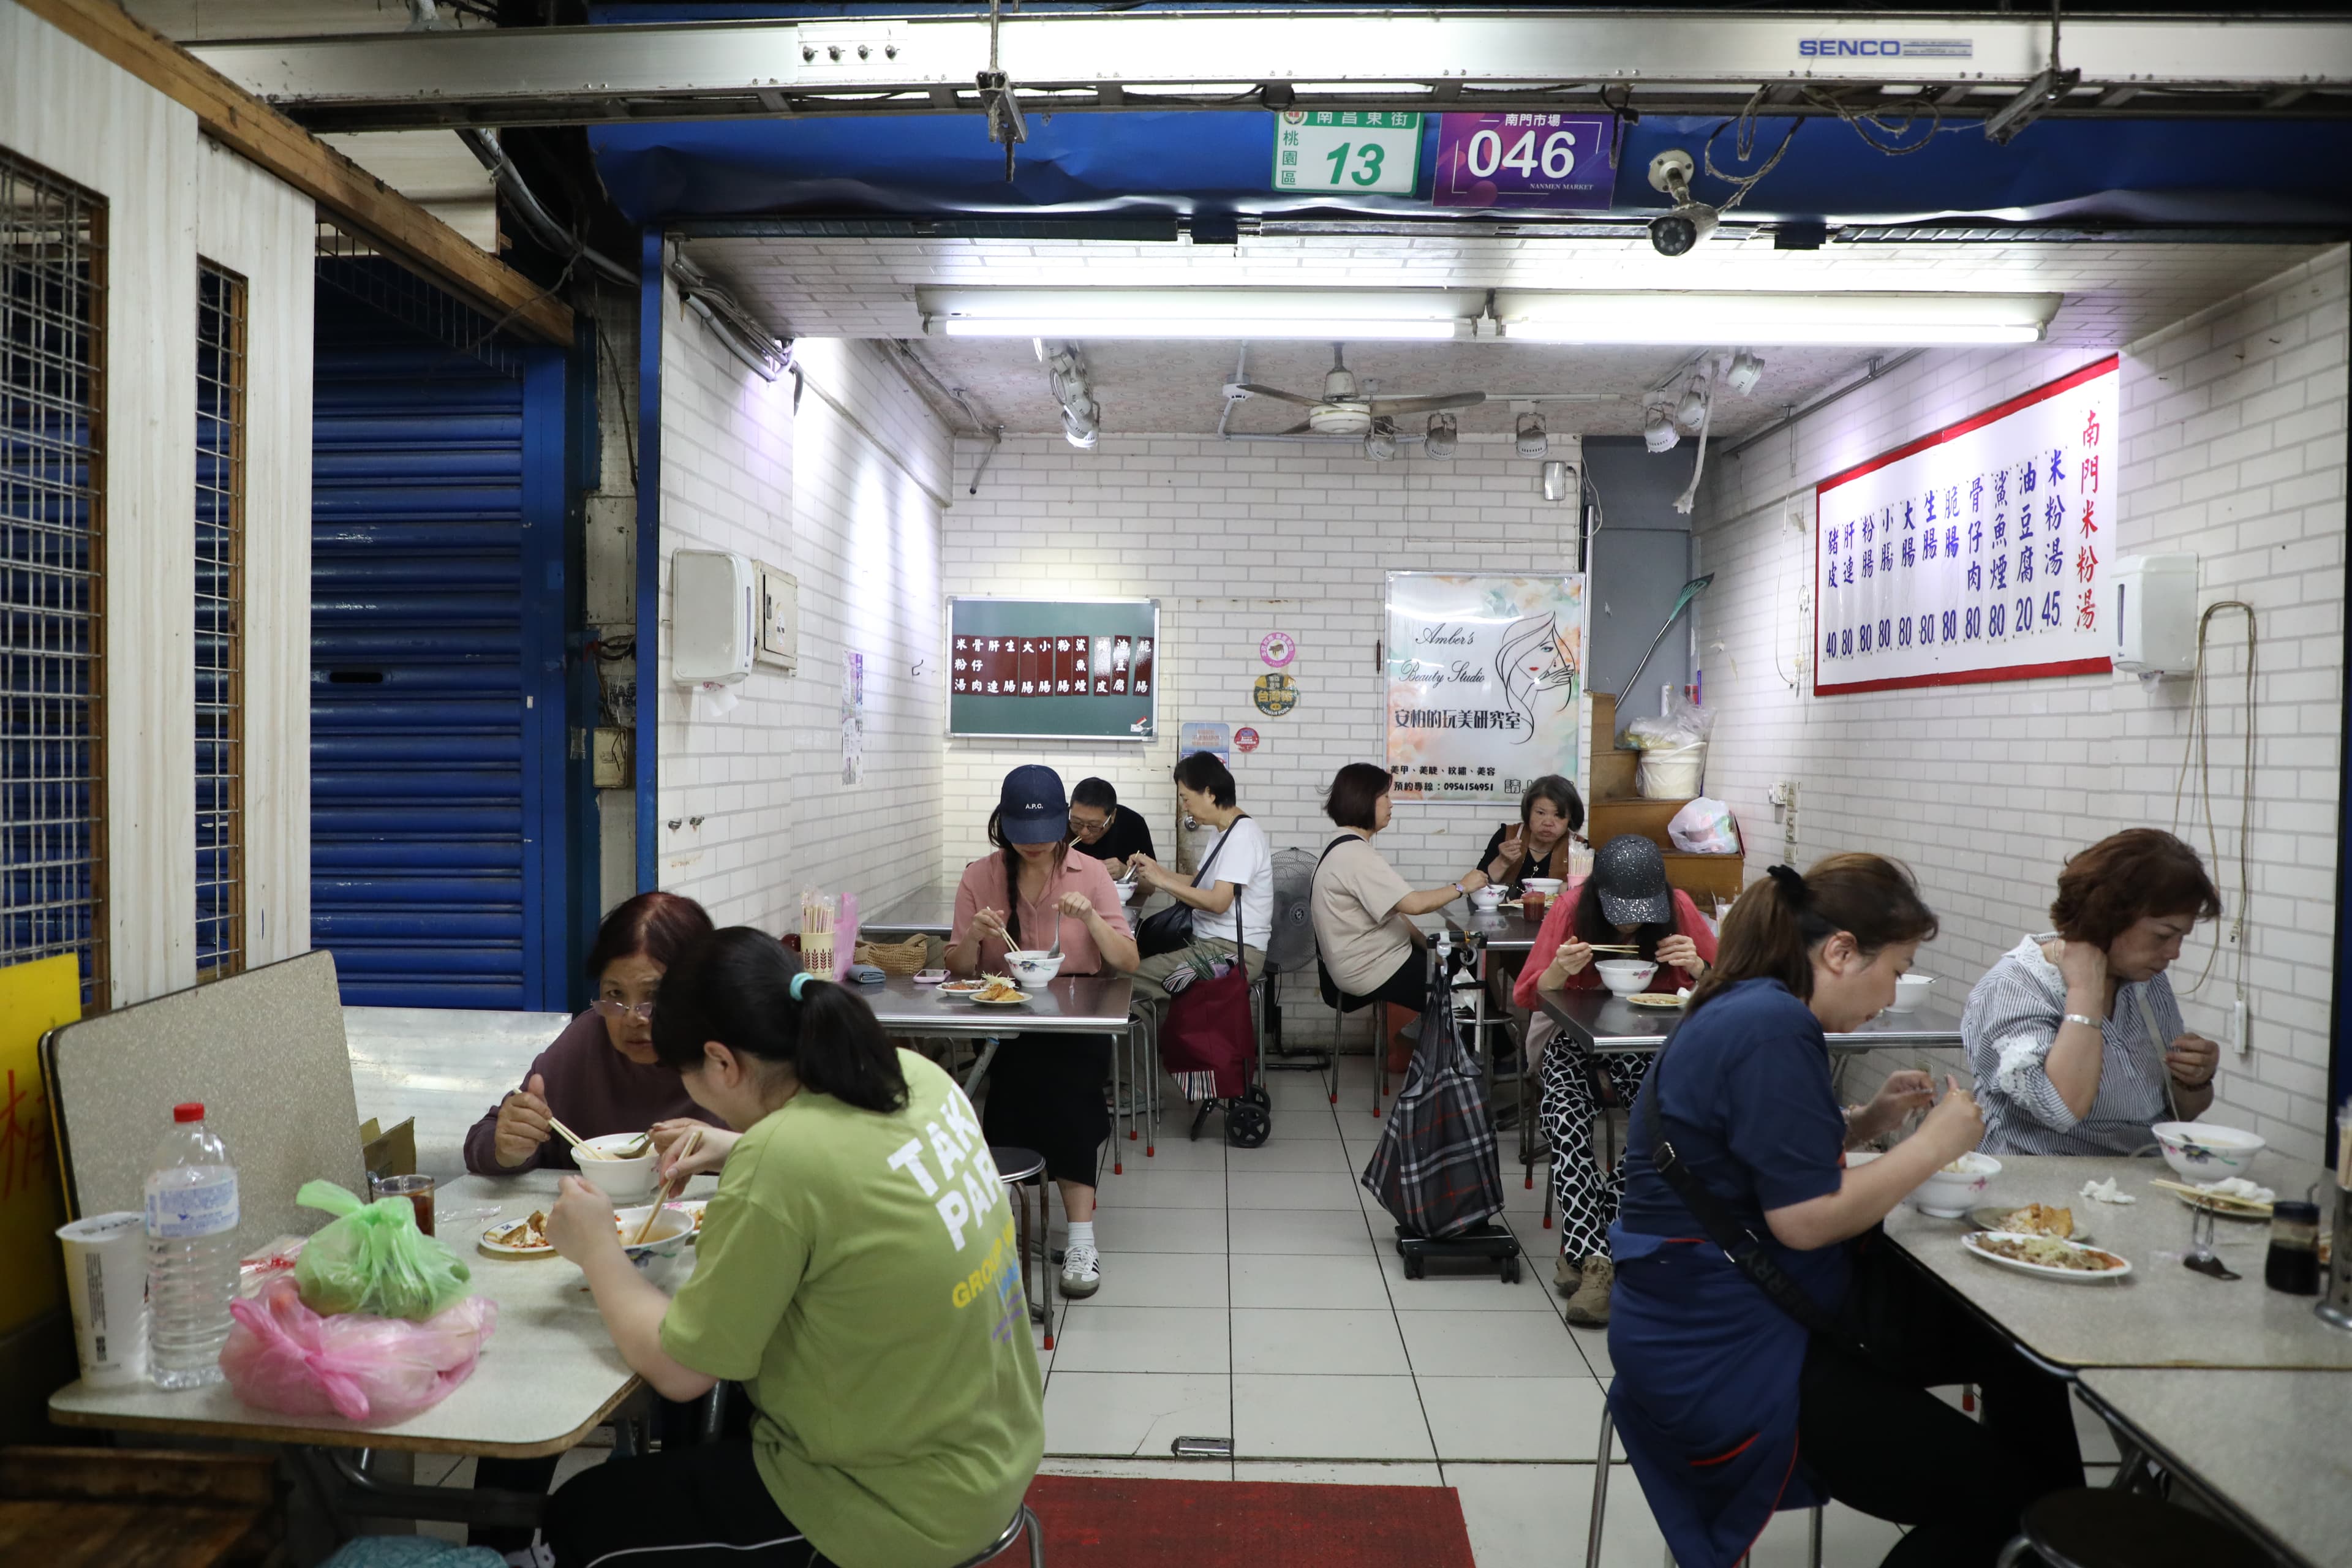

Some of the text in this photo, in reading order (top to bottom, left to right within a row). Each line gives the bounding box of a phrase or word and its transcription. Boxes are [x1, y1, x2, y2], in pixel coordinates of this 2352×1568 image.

[1800, 40, 1900, 56] SENCO
[1317, 111, 1408, 126] 南昌東街
[1505, 113, 1561, 127] 南門市場
[1281, 130, 1298, 184] 桃園區
[1326, 142, 1385, 186] 13
[1468, 129, 1576, 178] 046
[2015, 461, 2037, 632] 油豆腐 20
[2041, 449, 2066, 628] 米粉湯 45
[2076, 410, 2100, 630] 南門米粉湯
[1860, 515, 1875, 652] 粉腸 80
[1879, 508, 1894, 647] 小腸 80
[1899, 500, 1916, 646] 大腸 80
[1920, 490, 1938, 645] 生腸 80
[1942, 486, 1960, 642] 脆腸 80
[1965, 477, 1983, 639] 骨仔肉 80
[1842, 520, 1855, 656] 肝連 80
[1415, 623, 1475, 644] Amber's
[1826, 631, 1836, 658] 40
[1988, 603, 2005, 638] 80
[954, 638, 967, 691] 米粉湯
[971, 639, 984, 692] 骨仔肉
[1003, 639, 1016, 693] 生腸
[1021, 641, 1035, 693] 大腸
[1038, 641, 1051, 693] 小腸
[1057, 639, 1071, 692] 粉腸
[1399, 660, 1485, 688] Beauty Studio
[1395, 709, 1520, 729] 安柏的玩美研究室
[887, 1082, 980, 1197] TAK
[935, 1142, 1005, 1251] PAR
